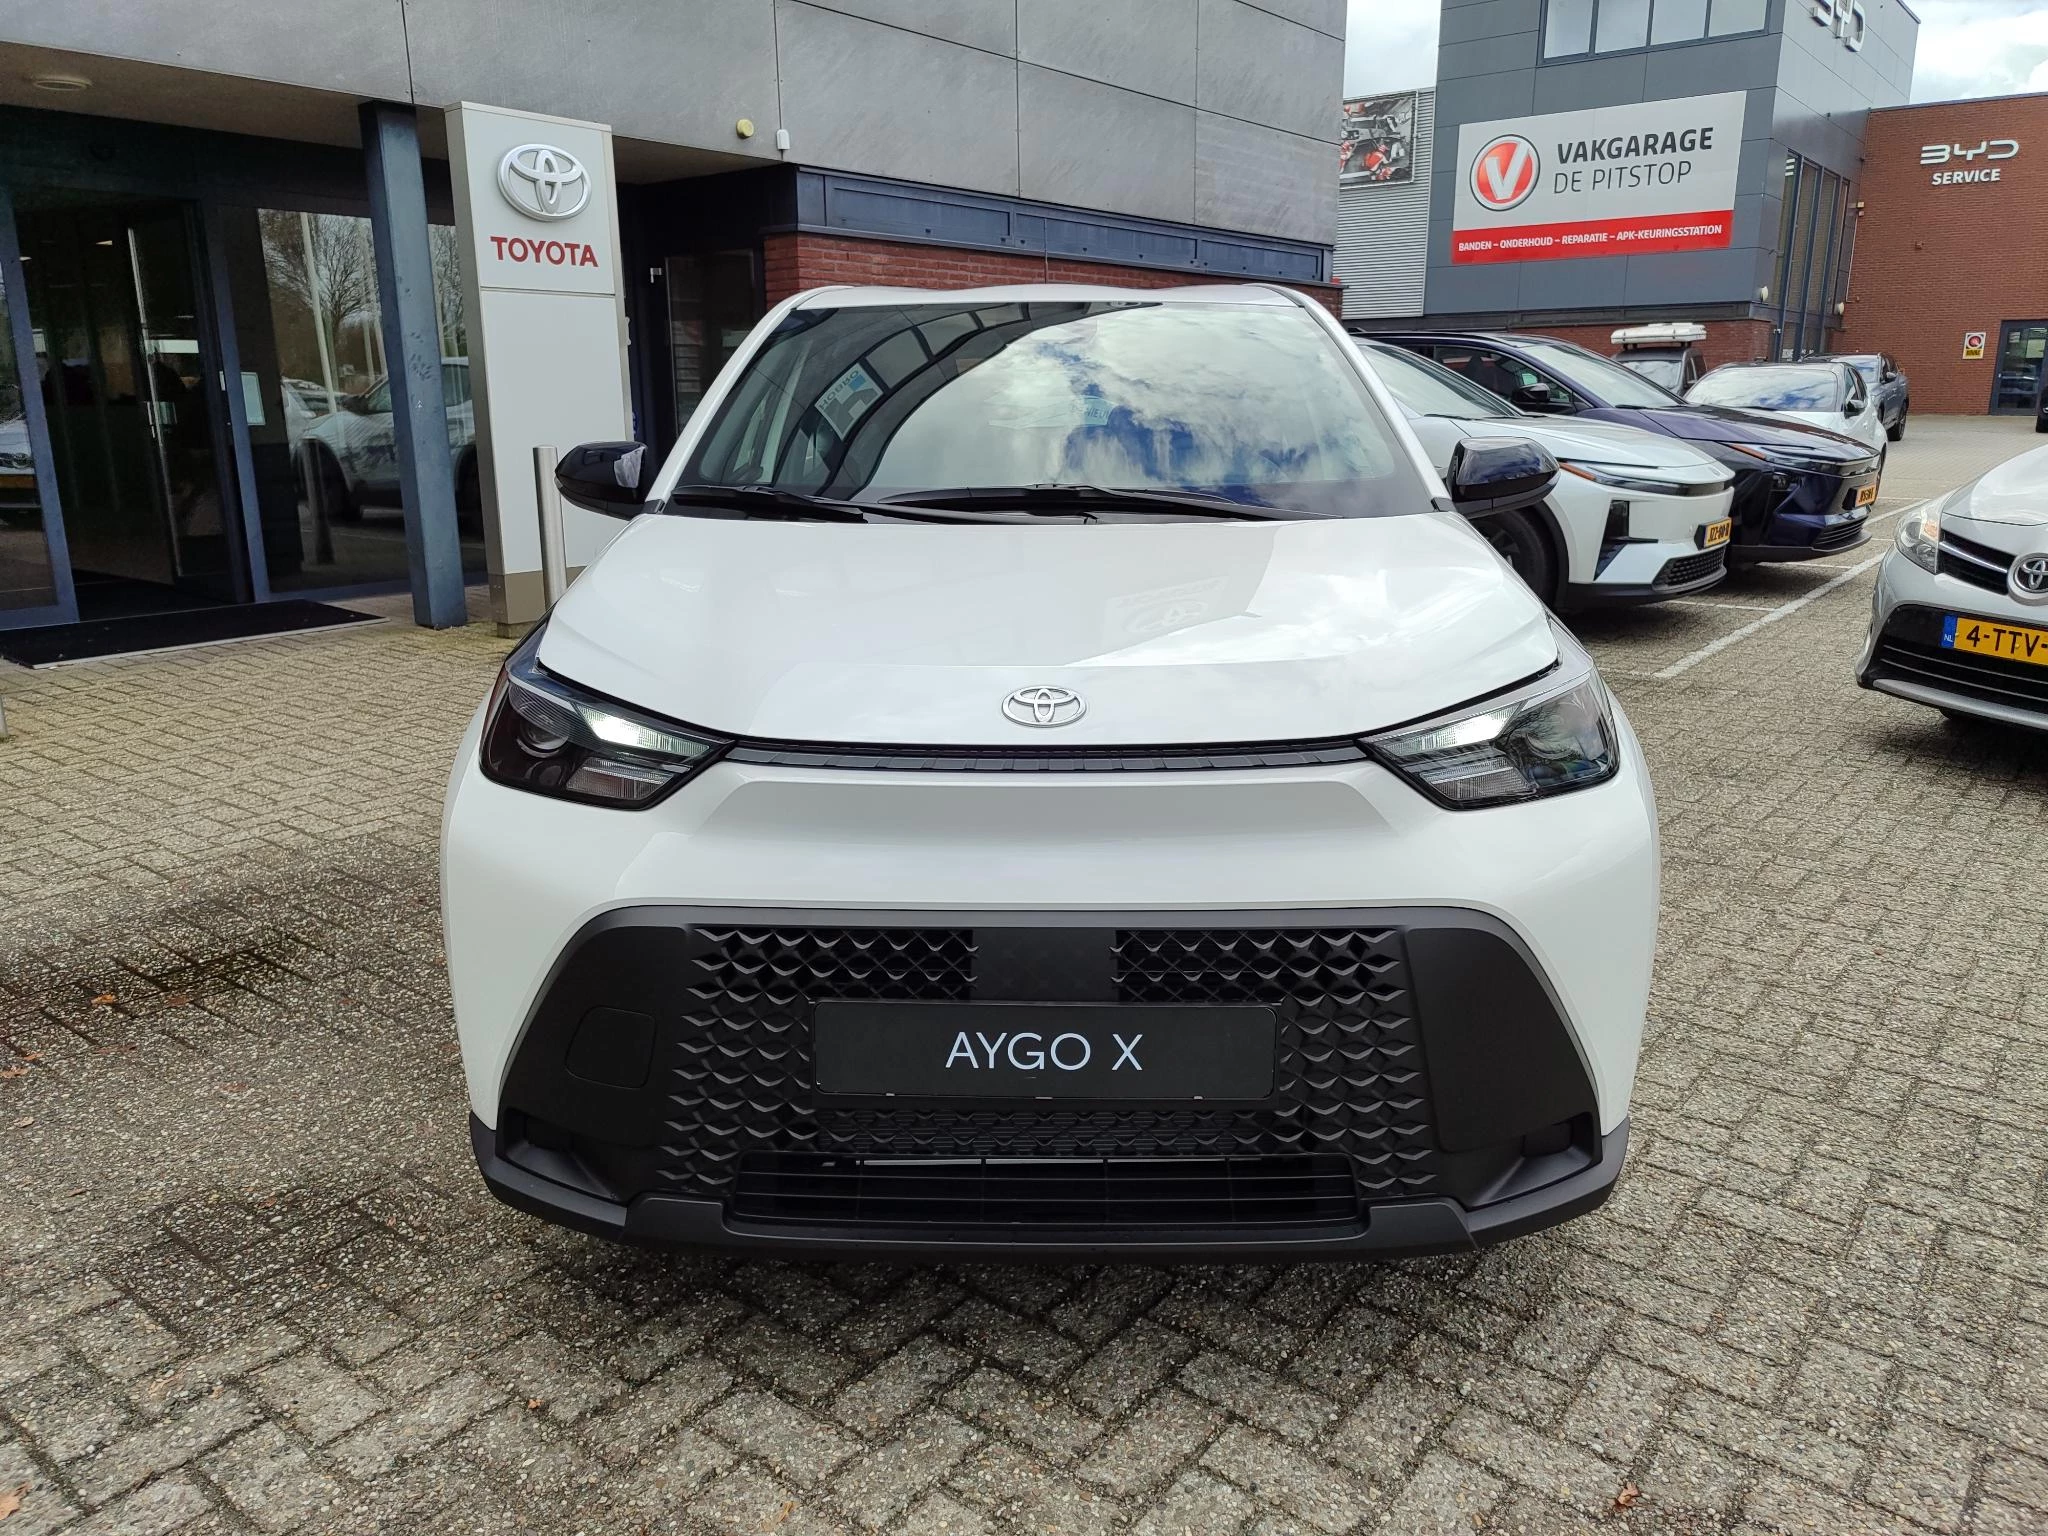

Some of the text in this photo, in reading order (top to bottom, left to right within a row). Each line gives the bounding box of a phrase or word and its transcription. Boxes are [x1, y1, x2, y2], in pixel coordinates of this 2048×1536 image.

[1557, 127, 1714, 164] VAKGARAGE
[1920, 139, 2019, 165] BYD
[1554, 161, 1692, 194] DE PITSTOP
[1931, 168, 2001, 186] SERVICE
[490, 236, 599, 268] TOYOTA
[1458, 241, 1492, 252] BANDEN
[1500, 236, 1553, 249] ONDERHOUD
[1561, 232, 1608, 245] REPARATIE
[1616, 225, 1723, 241] APK-KEURINGSSTATION
[1943, 633, 1954, 643] NL
[945, 1031, 1144, 1071] AYGO X
